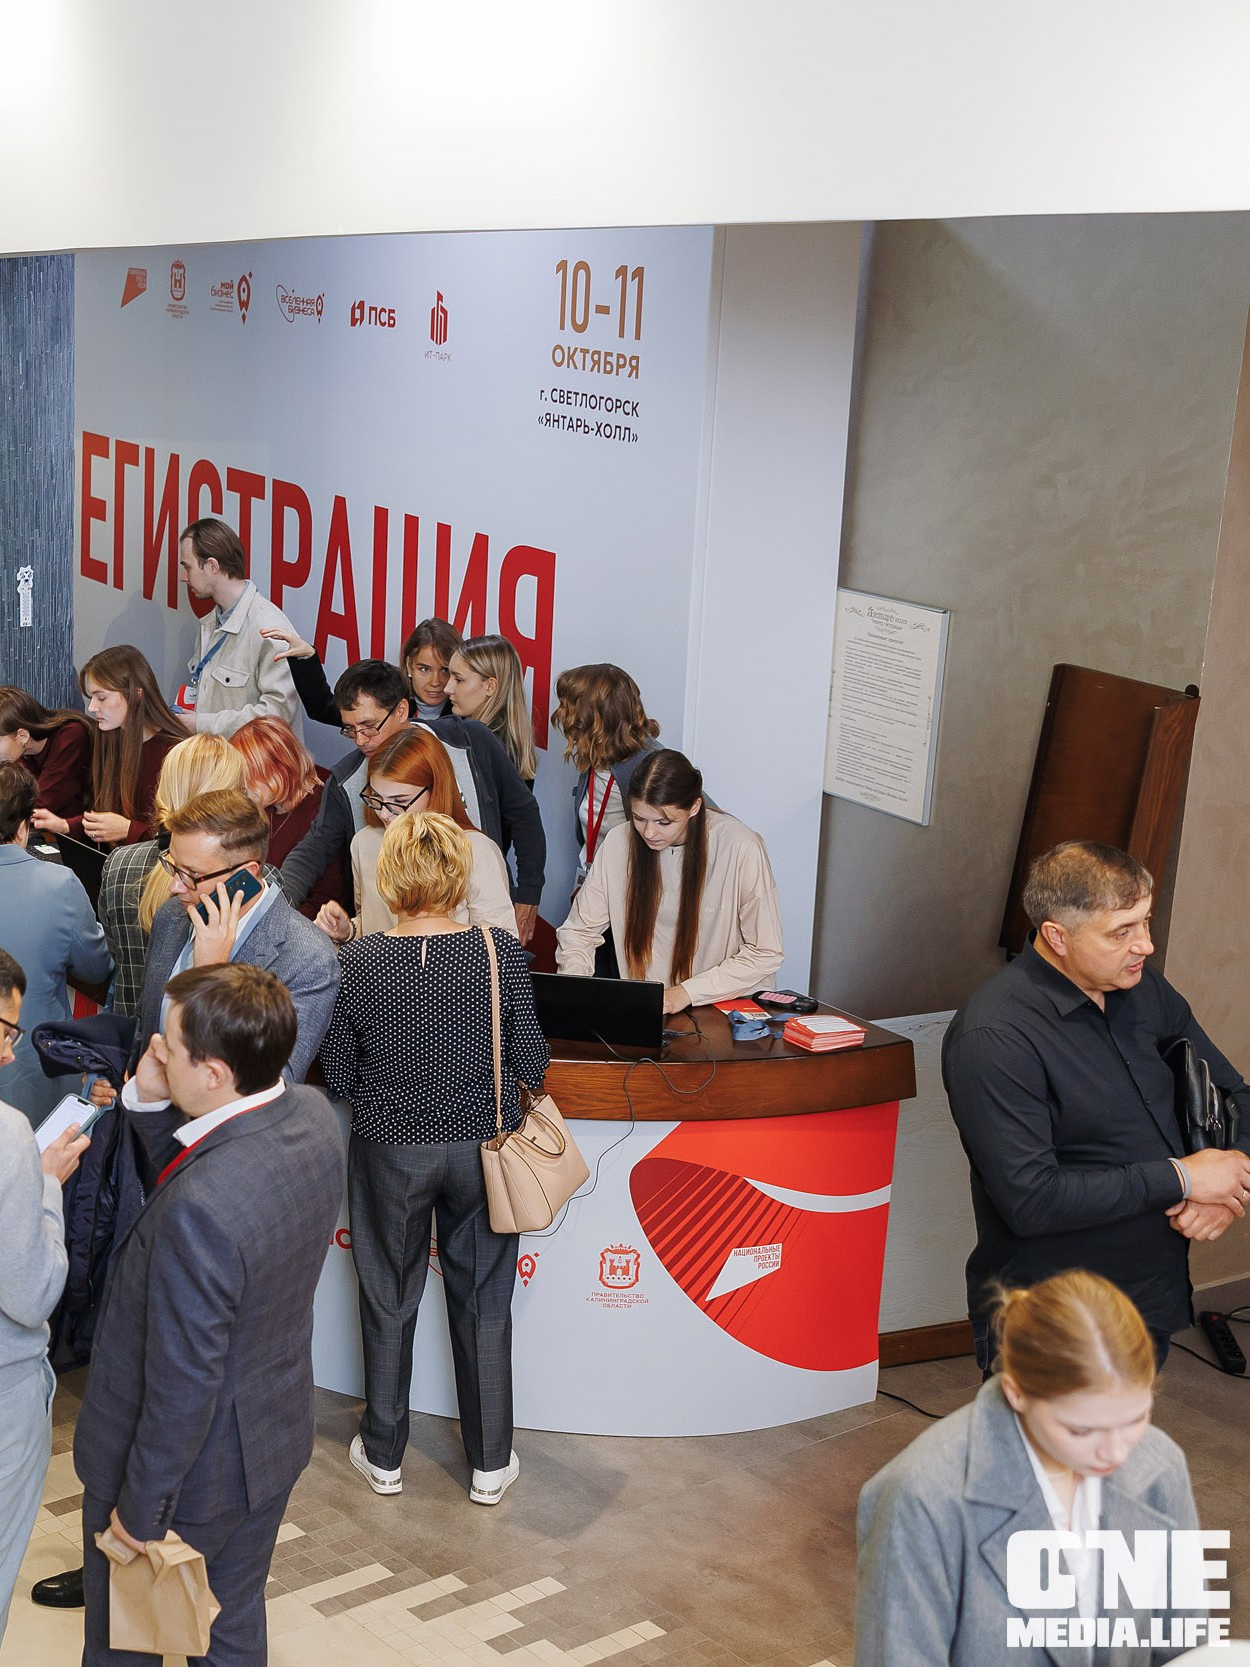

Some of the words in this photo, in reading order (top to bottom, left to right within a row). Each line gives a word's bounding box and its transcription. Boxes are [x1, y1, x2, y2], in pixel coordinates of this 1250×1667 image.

[368, 305, 397, 328] ПСБ
[424, 350, 452, 362] ИТ-ПАРК
[551, 344, 640, 379] ОКТЯБРЯ
[539, 389, 548, 402] г.
[550, 387, 640, 418] СВЕТЛОГОРСК
[537, 412, 639, 443] «ЯНТАРЬ-ХОЛЛ»
[80, 430, 556, 751] ЕГИСТРАЦИЯ
[733, 1244, 781, 1257] НАЦИОНАЛЬНЫЕ
[753, 1252, 781, 1263] ПРОЕКТЫ
[757, 1260, 780, 1270] РОССИИ
[591, 1291, 645, 1299] ПРАВИТЕЛЬСТВО
